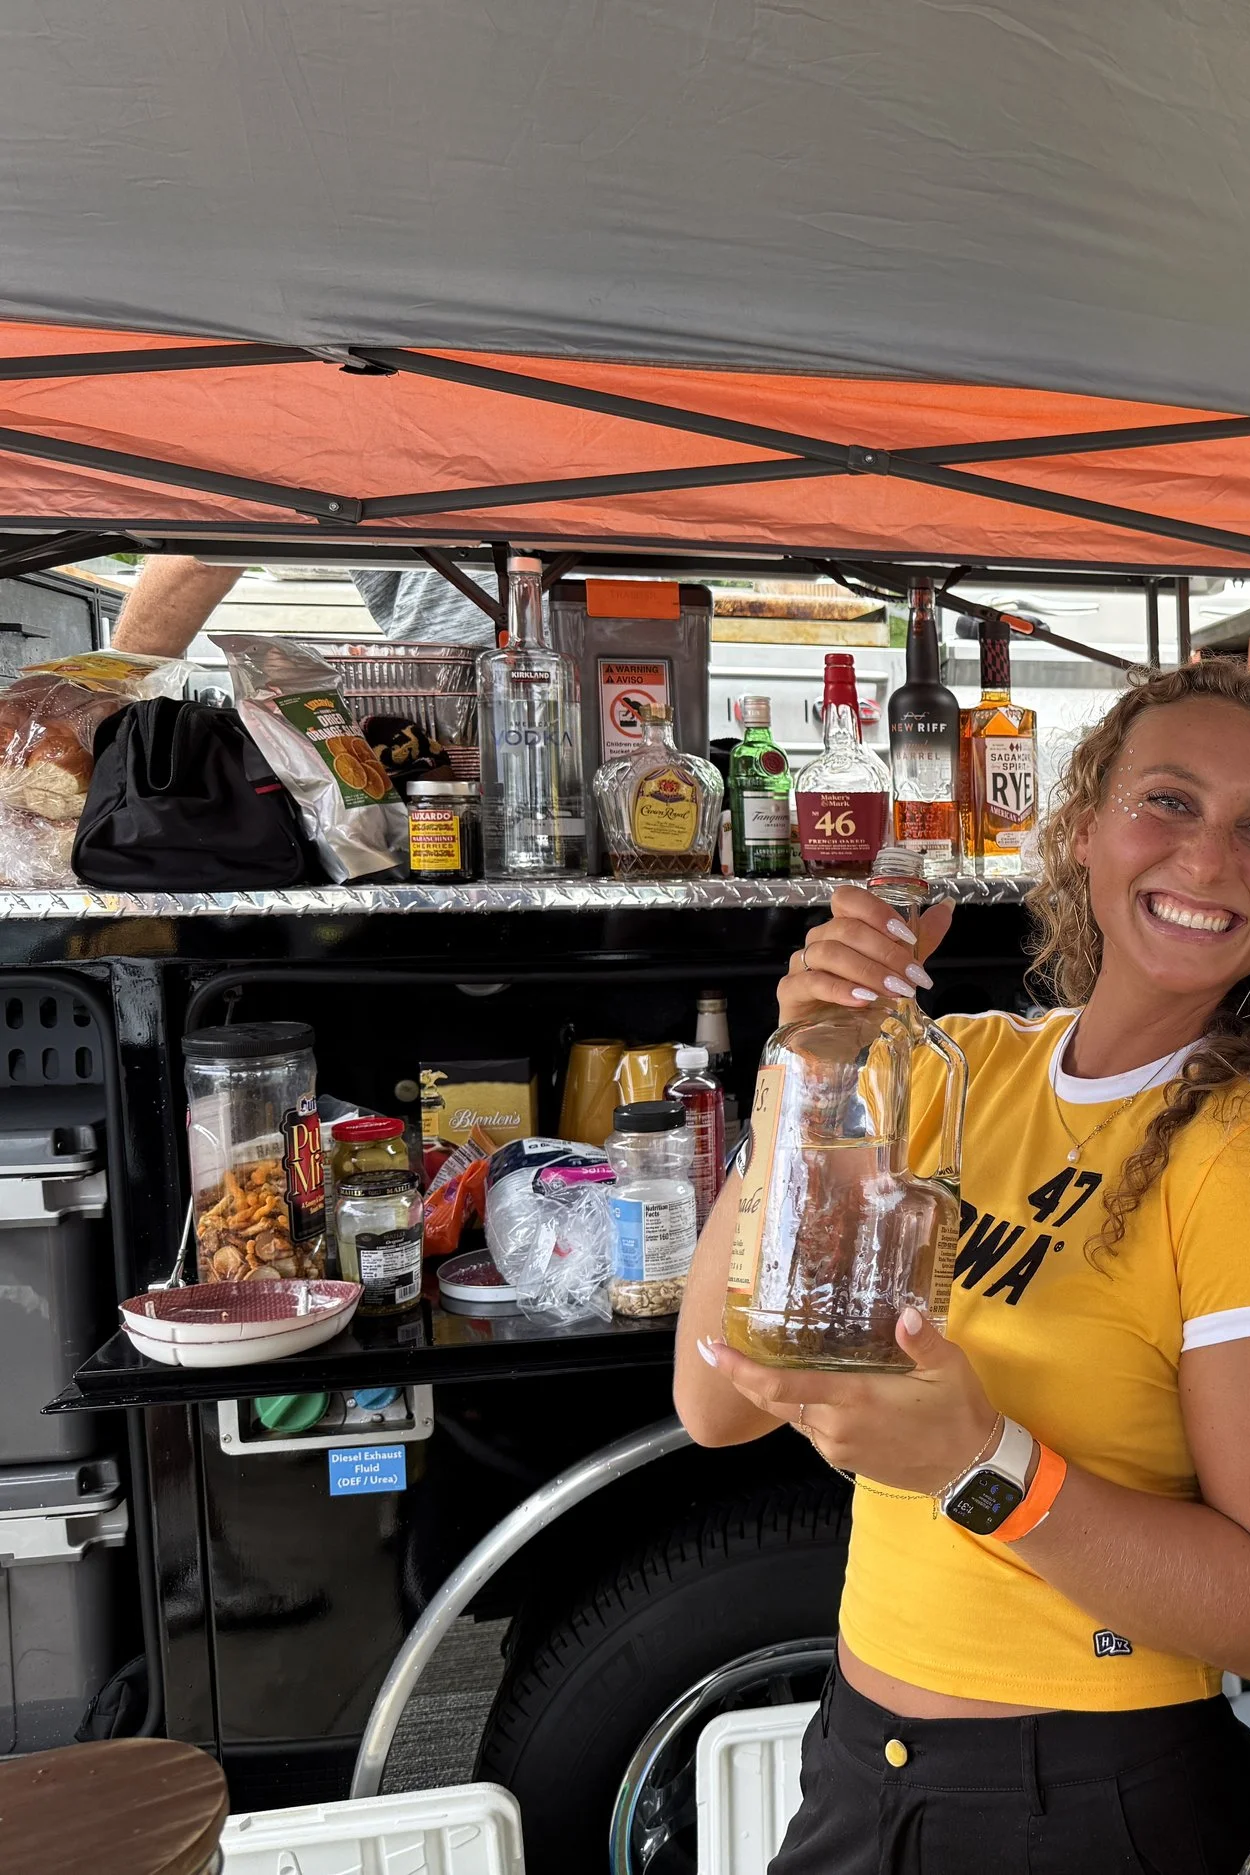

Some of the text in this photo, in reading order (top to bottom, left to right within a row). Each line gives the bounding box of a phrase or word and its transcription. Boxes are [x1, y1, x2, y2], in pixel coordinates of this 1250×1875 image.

[511, 671, 550, 679] KIRKLAND
[616, 665, 659, 673] WARNING
[616, 676, 644, 684] AVISO
[317, 713, 346, 727] DRIED
[891, 723, 947, 732] NEW RIFF
[306, 728, 341, 741] ORANGE
[492, 730, 573, 747] VODKA
[896, 752, 941, 761] BARREL
[992, 772, 1032, 811] RYE
[411, 812, 451, 820] LUXARDO
[814, 810, 856, 837] 46
[449, 1108, 521, 1129] Blanton's
[292, 1118, 322, 1161] Pu
[1027, 1166, 1103, 1228] 47
[331, 1450, 402, 1463] Diesel Exhaust
[355, 1463, 380, 1473] Fluid
[337, 1476, 362, 1488] (DEF
[369, 1474, 398, 1485] Urea)
